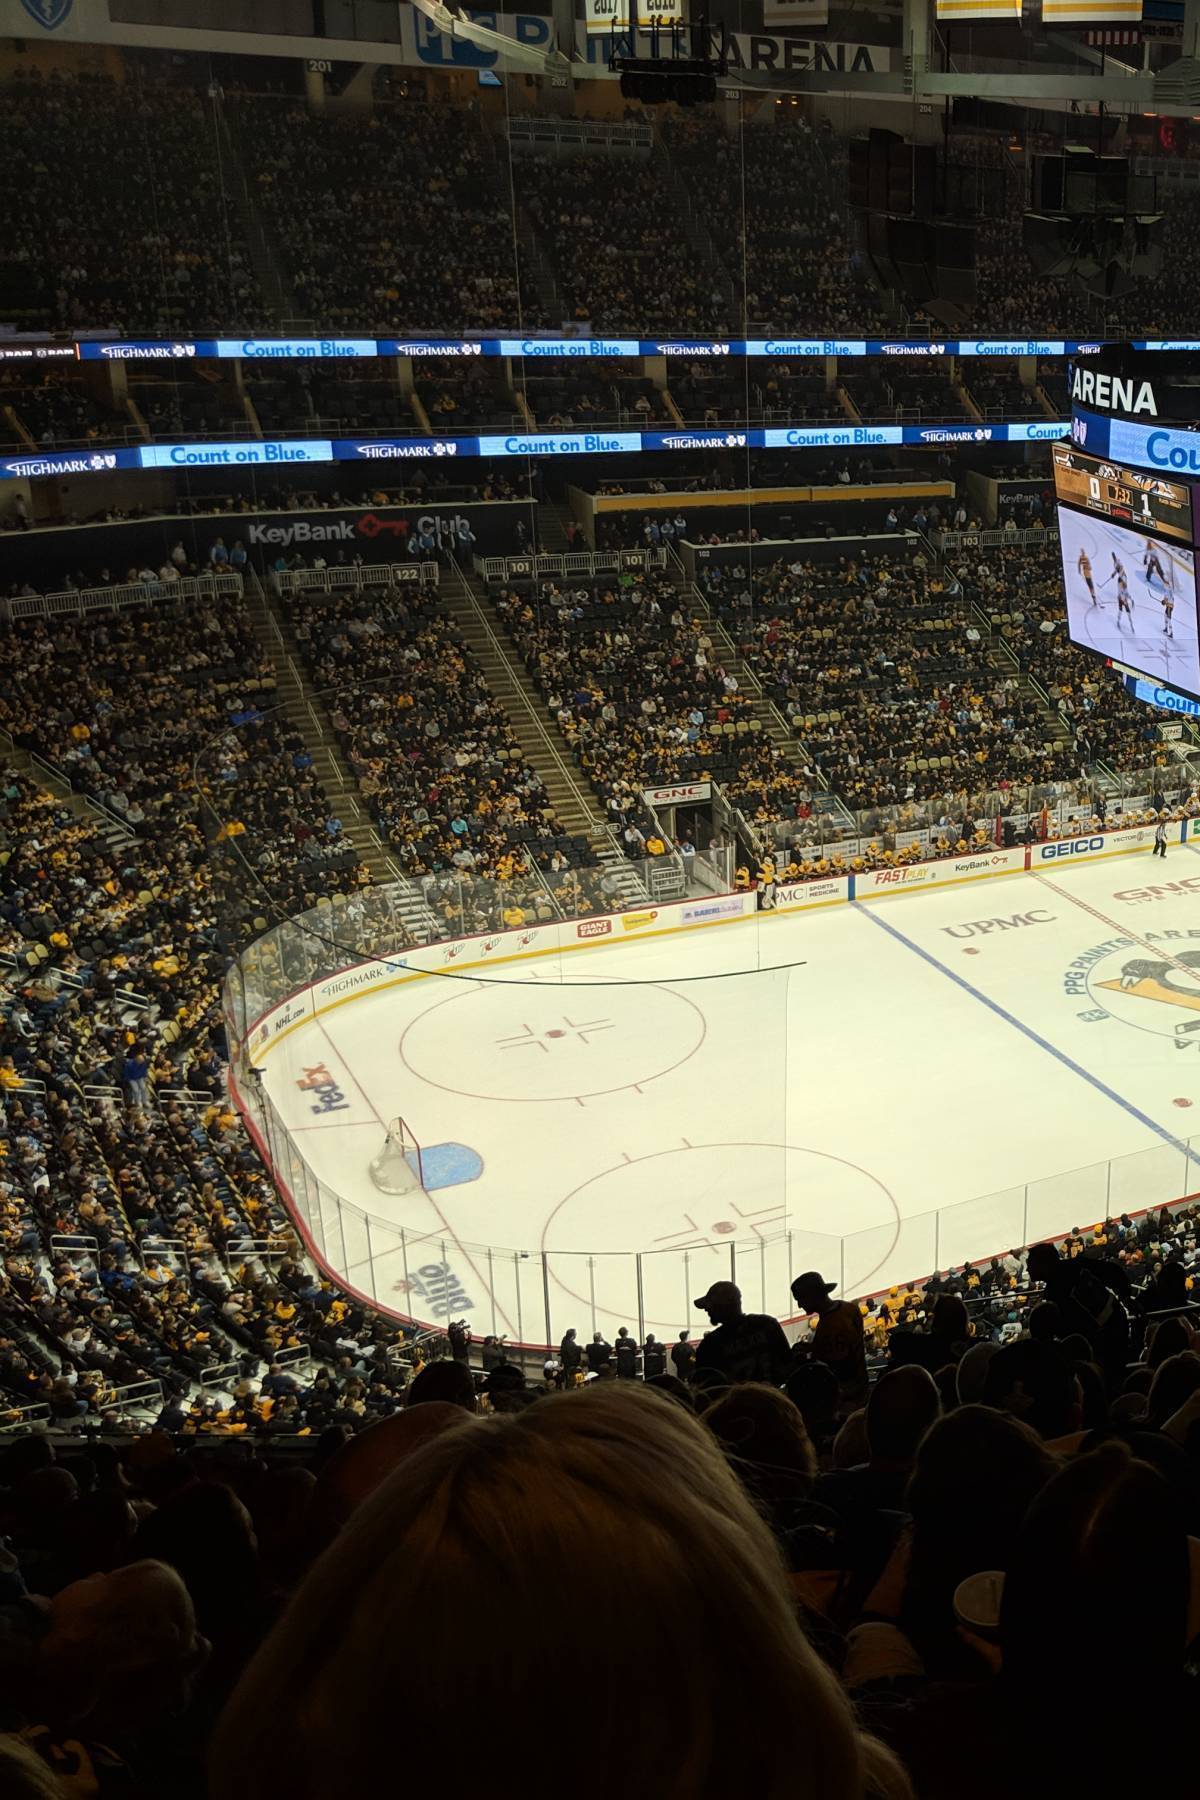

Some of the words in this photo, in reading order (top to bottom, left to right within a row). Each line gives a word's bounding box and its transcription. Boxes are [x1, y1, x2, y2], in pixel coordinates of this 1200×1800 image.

[714, 33, 880, 73] ARENA
[307, 59, 332, 73] 201
[105, 345, 173, 358] HIGHMARK
[243, 341, 292, 358] Count
[296, 345, 316, 357] on
[320, 342, 360, 358] Blue.
[404, 344, 460, 356] HIGHMARK
[521, 341, 566, 356] Count
[569, 345, 588, 356] on
[590, 342, 623, 356] Blue.
[662, 344, 713, 355] HIGHMARK
[765, 341, 803, 356] Count
[805, 345, 821, 356] on
[822, 342, 853, 356] Blue.
[885, 344, 929, 356] HIGHMARK
[975, 342, 1008, 356] Count
[1010, 345, 1025, 356] on
[1071, 366, 1159, 417] ARENA
[786, 430, 829, 446] Count
[832, 434, 851, 445] on
[854, 429, 887, 444] Blue.
[924, 430, 974, 442] HIGHMARK
[1026, 424, 1063, 439] Count
[504, 436, 556, 455] Count
[559, 440, 580, 453] on
[584, 435, 624, 453] Blue.
[664, 436, 726, 450] HIGHMARK
[171, 445, 231, 465] Count
[235, 450, 260, 464] on
[264, 443, 311, 463] Blue.
[364, 443, 434, 459] HIGHMARK
[14, 460, 90, 477] HIGHMARK
[1089, 477, 1101, 500] 0
[1114, 487, 1131, 504] 7:32
[1000, 494, 1040, 504] KeyBank
[1141, 493, 1152, 517] 1
[250, 520, 357, 546] KeyBank
[417, 514, 471, 535] Club
[962, 537, 979, 546] 103
[511, 562, 529, 573] 101
[626, 555, 643, 566] 101
[396, 569, 418, 580] 122
[653, 786, 702, 799] GNC
[1041, 837, 1104, 859] GEICO
[955, 859, 990, 872] KeyBank
[809, 883, 834, 892] SPORTS
[809, 888, 840, 898] MEDICINE
[1125, 894, 1163, 906] LIVE
[579, 921, 609, 932] GIANT
[580, 926, 610, 936] EAGLE
[940, 909, 1057, 939] UPMC
[1063, 971, 1087, 996] PPG
[1076, 936, 1136, 972] PAINTS
[325, 967, 384, 997] HIGHMARK
[296, 1061, 350, 1115] FedEx
